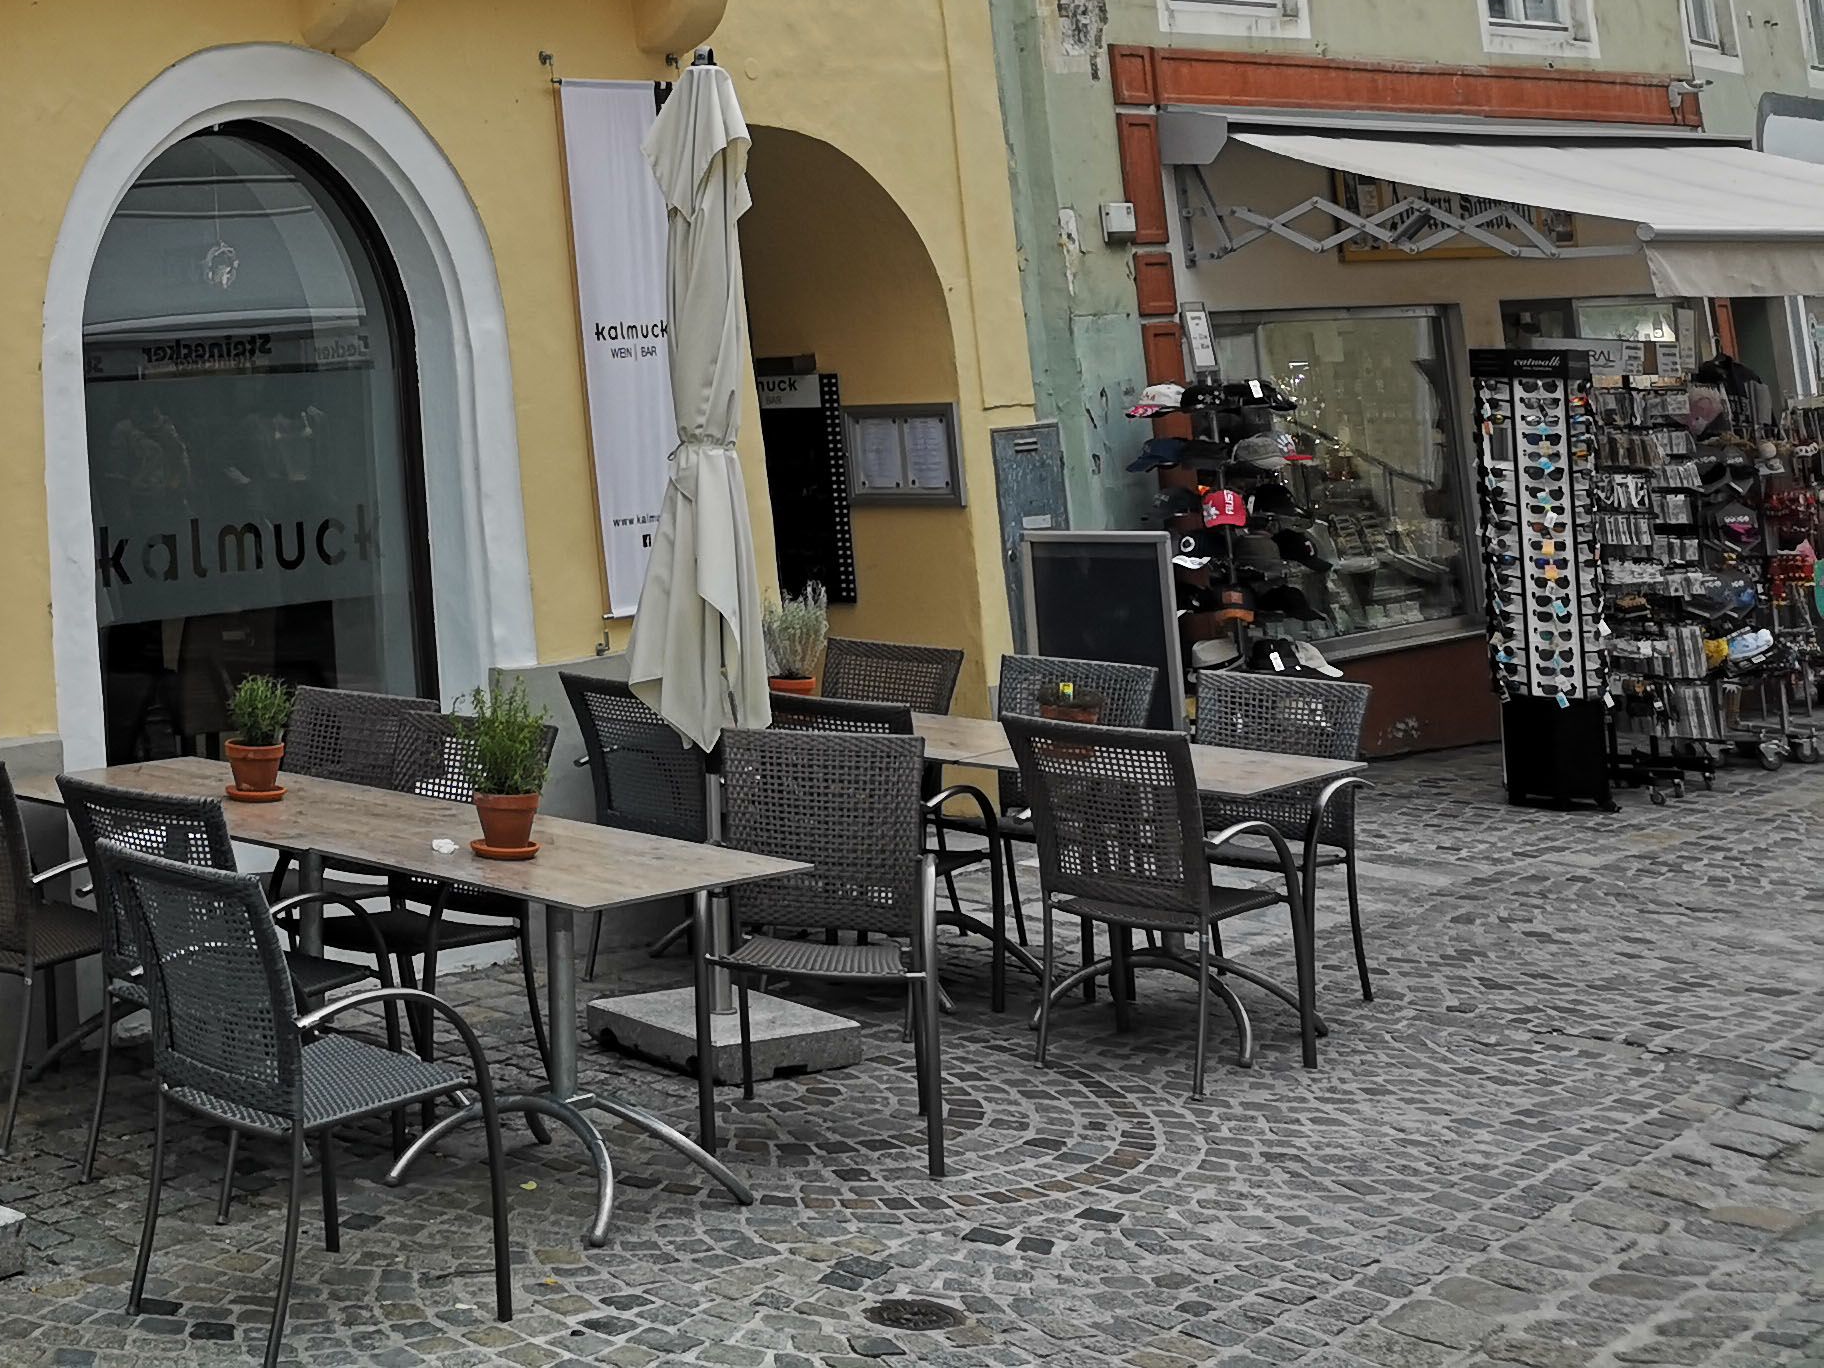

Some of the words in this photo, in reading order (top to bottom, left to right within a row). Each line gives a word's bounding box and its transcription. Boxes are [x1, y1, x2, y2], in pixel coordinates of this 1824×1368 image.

[595, 319, 669, 342] kalmuck
[611, 347, 633, 359] WEIN
[640, 345, 657, 358] BAR
[96, 503, 373, 588] kalmuck
